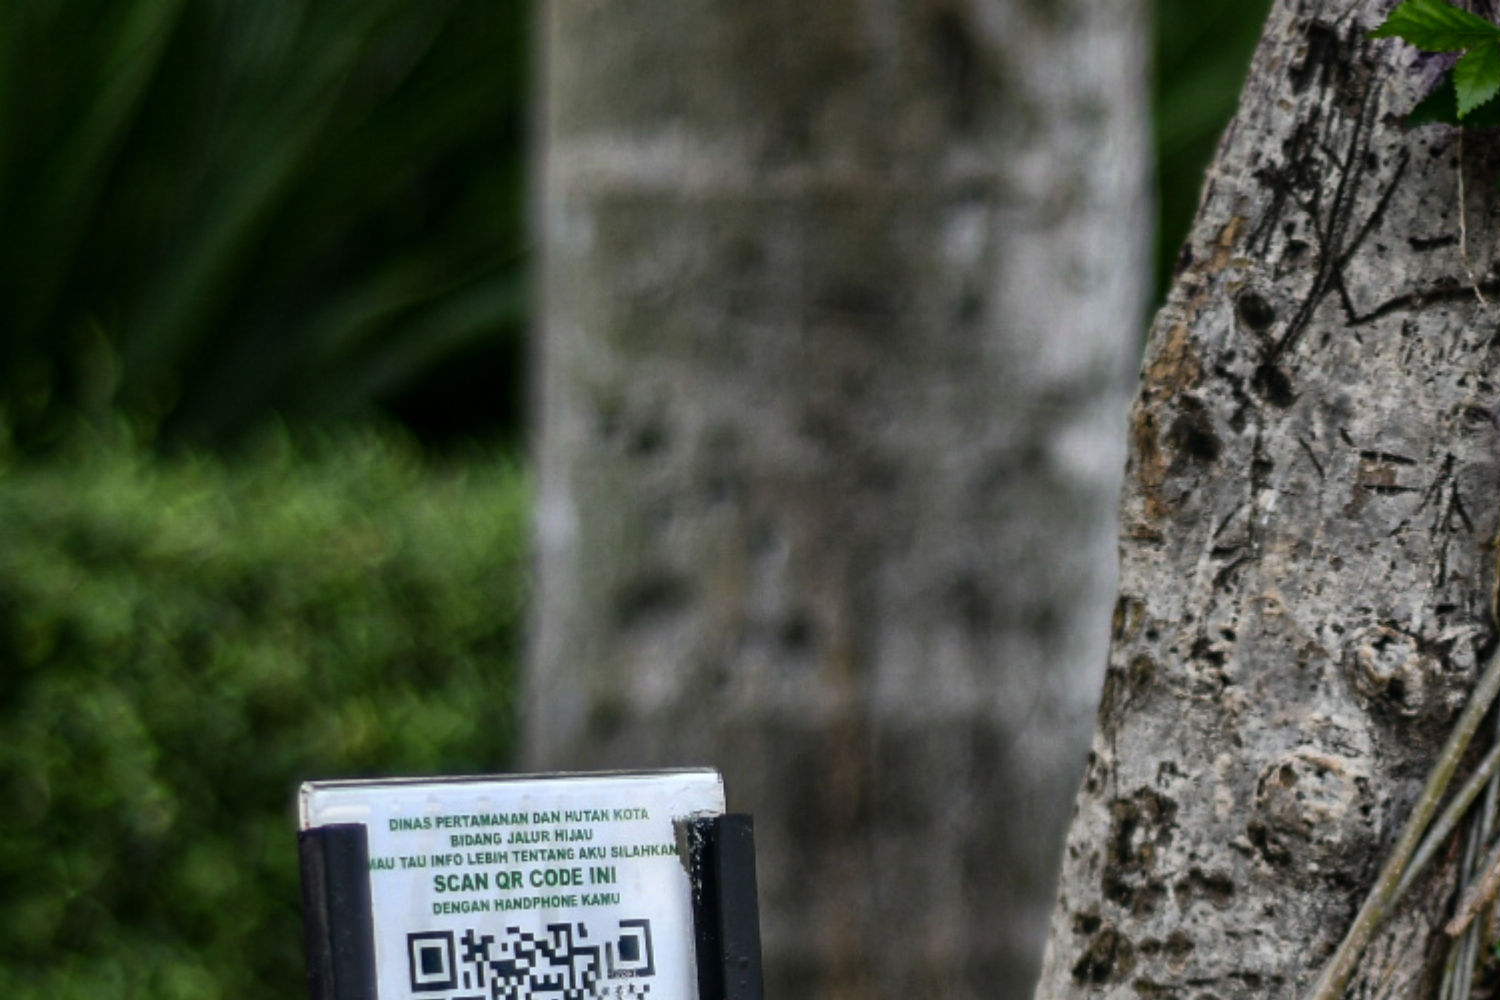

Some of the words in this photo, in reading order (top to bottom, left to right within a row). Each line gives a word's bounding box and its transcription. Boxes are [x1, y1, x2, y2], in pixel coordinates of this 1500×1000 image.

[389, 816, 432, 831] DINAS
[435, 812, 528, 828] PERTAMANAN
[533, 810, 560, 824] DAN
[565, 809, 609, 822] HUTAN
[613, 808, 649, 821] KOTA
[451, 832, 502, 847] BIDANG
[507, 830, 550, 844] JALUR
[555, 828, 593, 842] HIJAU
[400, 855, 426, 868] TAU
[431, 853, 462, 867] INFO
[467, 851, 508, 865] LEBIH
[512, 848, 574, 863] TENTANG
[579, 846, 606, 860] AKU
[611, 843, 678, 858] SILAHKAN
[434, 872, 489, 893] SCAN
[495, 870, 523, 890] QR
[529, 867, 583, 888] CODE
[590, 866, 617, 884] INI
[433, 900, 490, 915] DENGAN
[495, 894, 578, 912] HANDPHONE
[581, 892, 620, 907] KAMU
